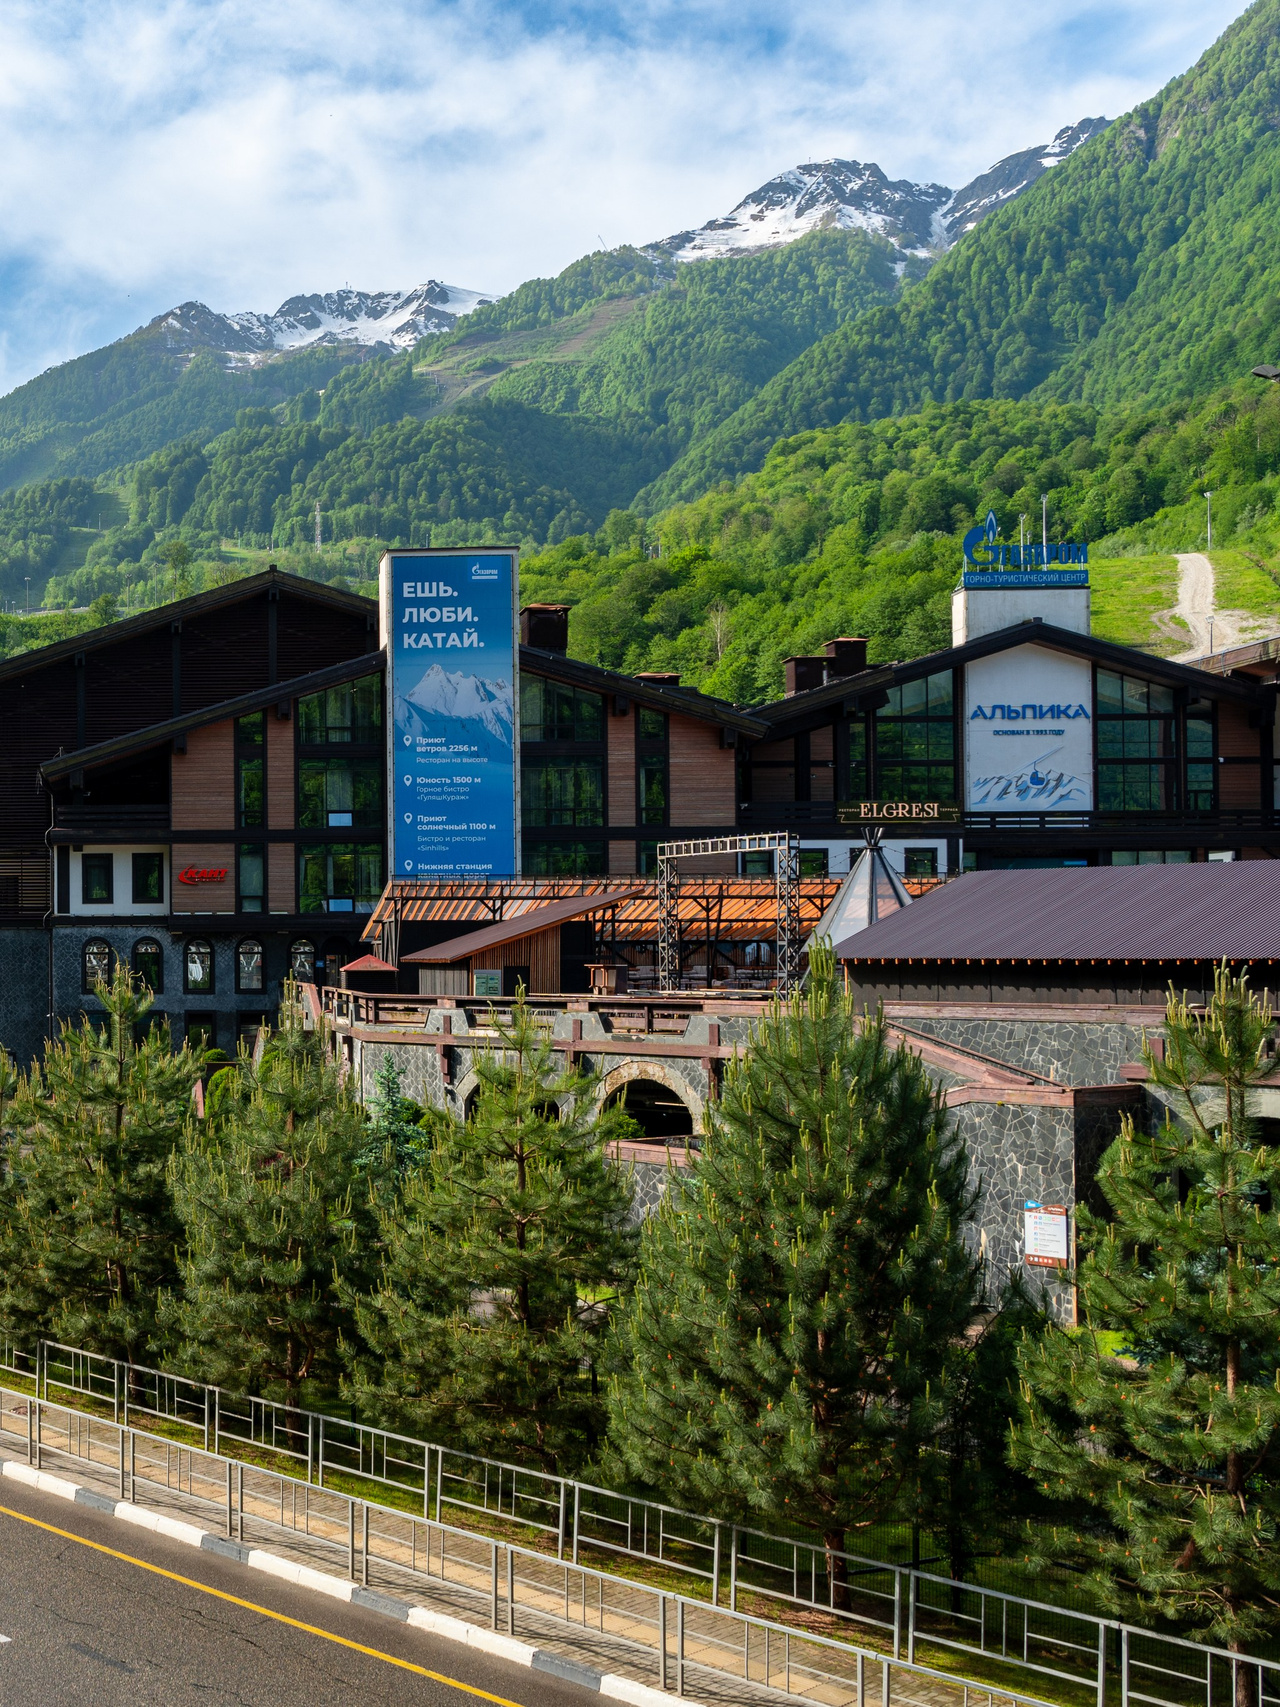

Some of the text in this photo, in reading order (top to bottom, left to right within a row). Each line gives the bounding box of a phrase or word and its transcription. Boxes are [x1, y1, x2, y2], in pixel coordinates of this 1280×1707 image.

[965, 573, 1086, 583] ГОРНО-ТУРИСТИЧЕСКИЙ ЦЕНТР
[403, 582, 458, 597] ЕШЬ.
[402, 607, 479, 623] ЛЮБИ.
[403, 628, 485, 648] КАТАЙ.
[970, 704, 1091, 720] АЛЬПИКА
[859, 803, 939, 818] ELGRESI
[417, 815, 447, 823] Приют
[187, 869, 229, 877] КАНТ
